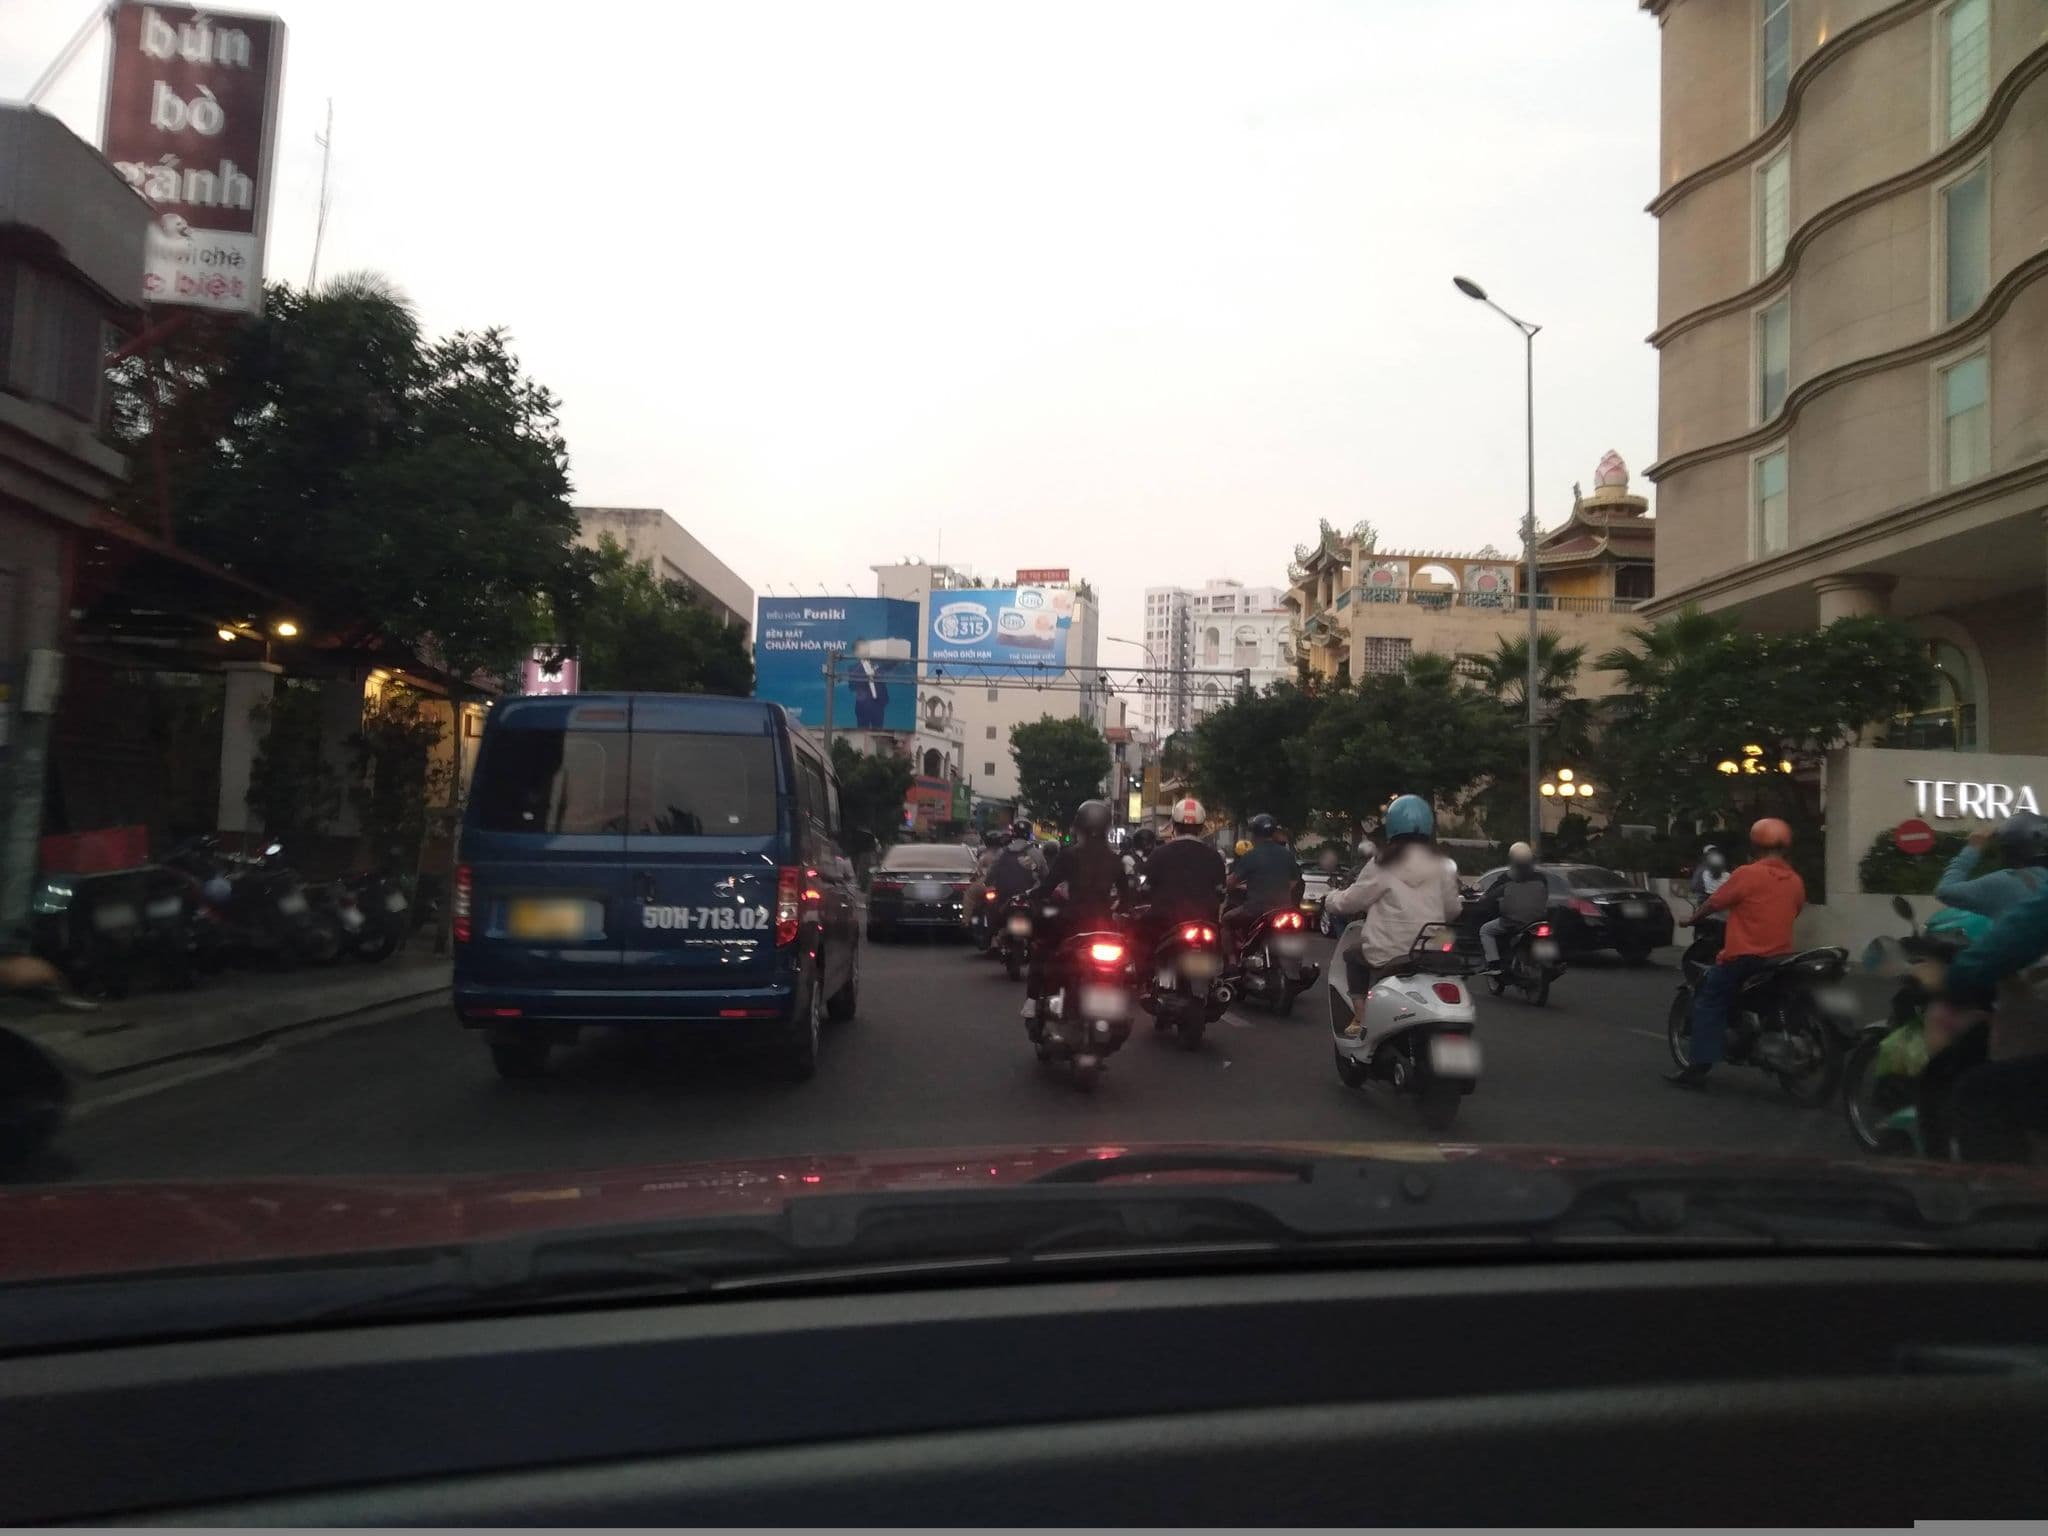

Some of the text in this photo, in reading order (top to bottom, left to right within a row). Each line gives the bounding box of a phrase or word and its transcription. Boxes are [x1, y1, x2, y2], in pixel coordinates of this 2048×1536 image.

[140, 6, 250, 67] bún
[151, 80, 224, 135] bò
[804, 608, 846, 620] Funiki
[960, 622, 984, 635] 315
[1907, 779, 2040, 819] TERRA
[642, 905, 769, 930] 50H-713.02
